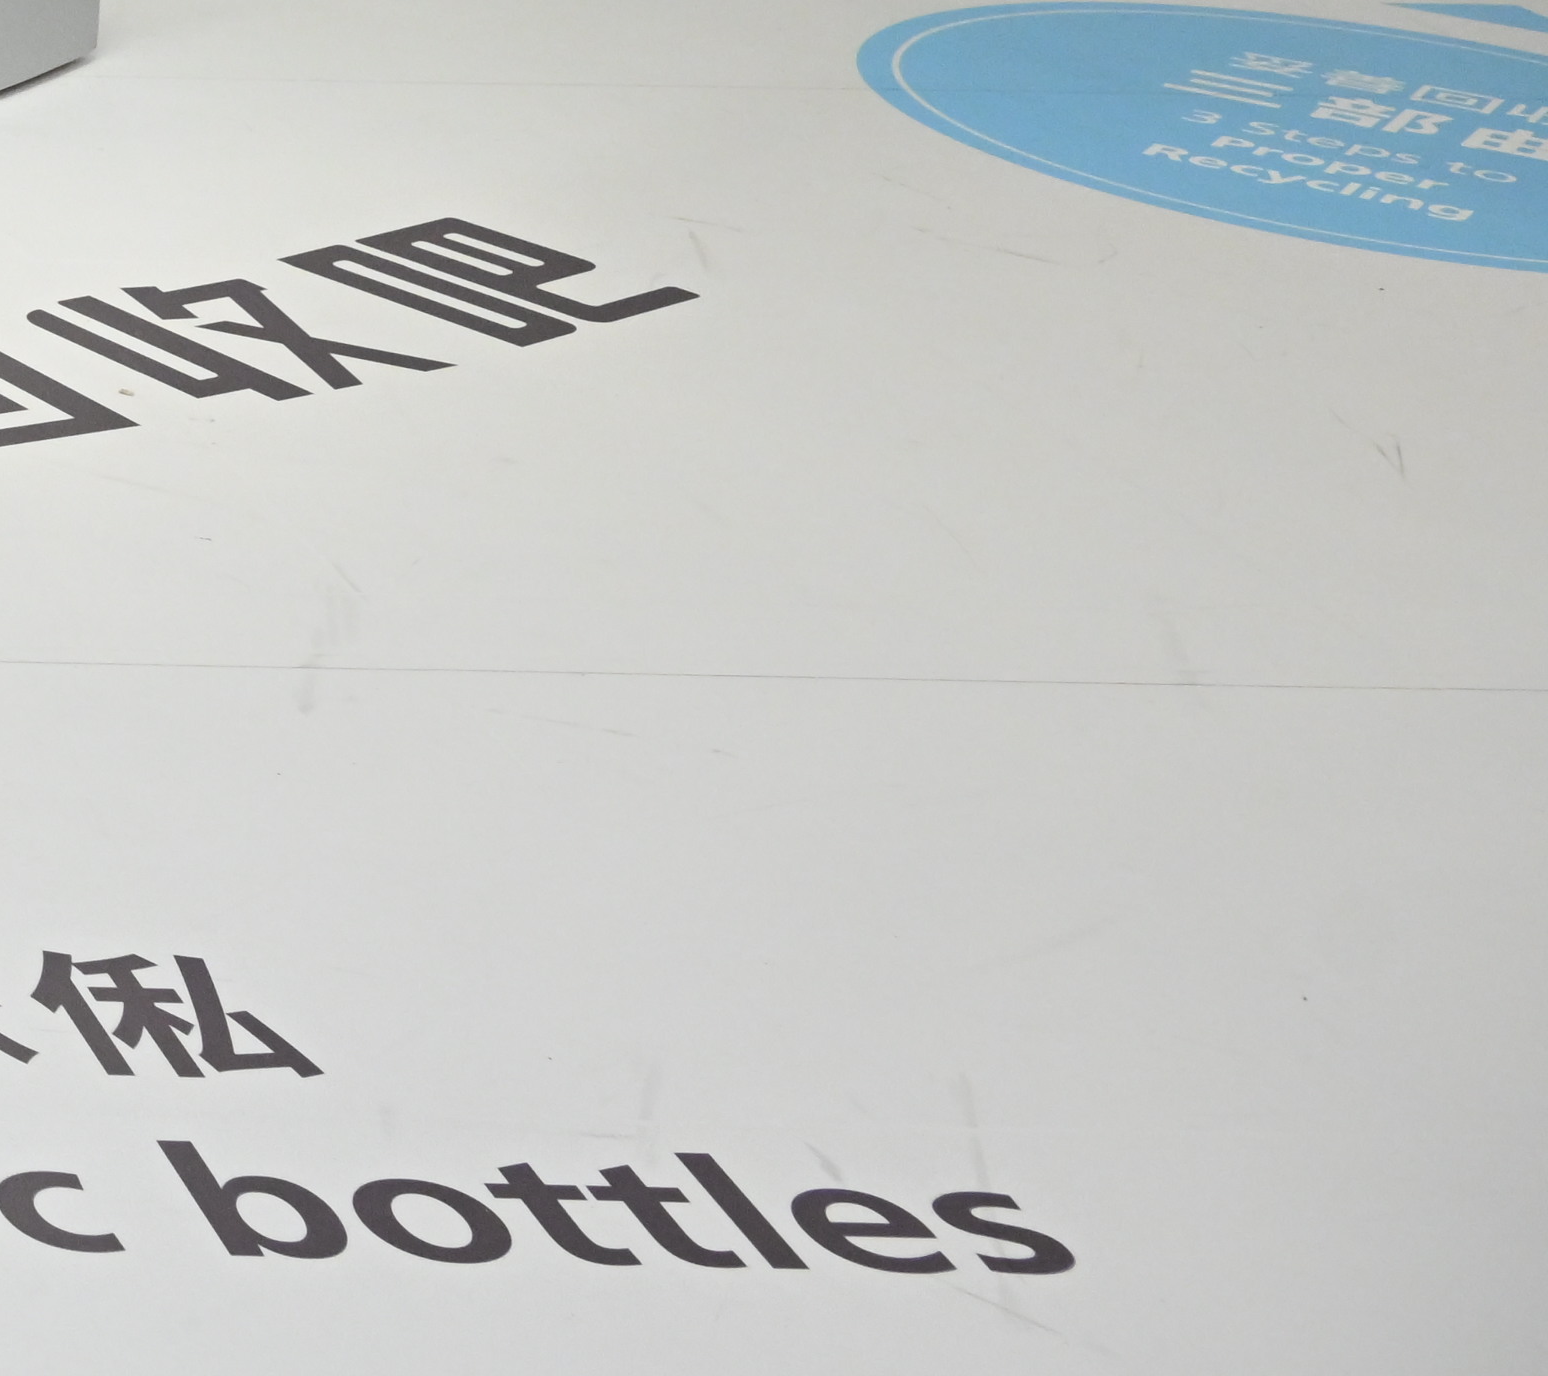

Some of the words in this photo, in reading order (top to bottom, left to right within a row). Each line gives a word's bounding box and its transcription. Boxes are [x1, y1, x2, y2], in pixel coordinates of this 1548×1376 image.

[1141, 142, 1476, 223] Recycling
[1185, 110, 1223, 124] 3
[1240, 120, 1422, 166] Steps
[1446, 160, 1519, 184] to
[1209, 134, 1454, 192] Proper
[156, 1140, 1077, 1276] bottles
